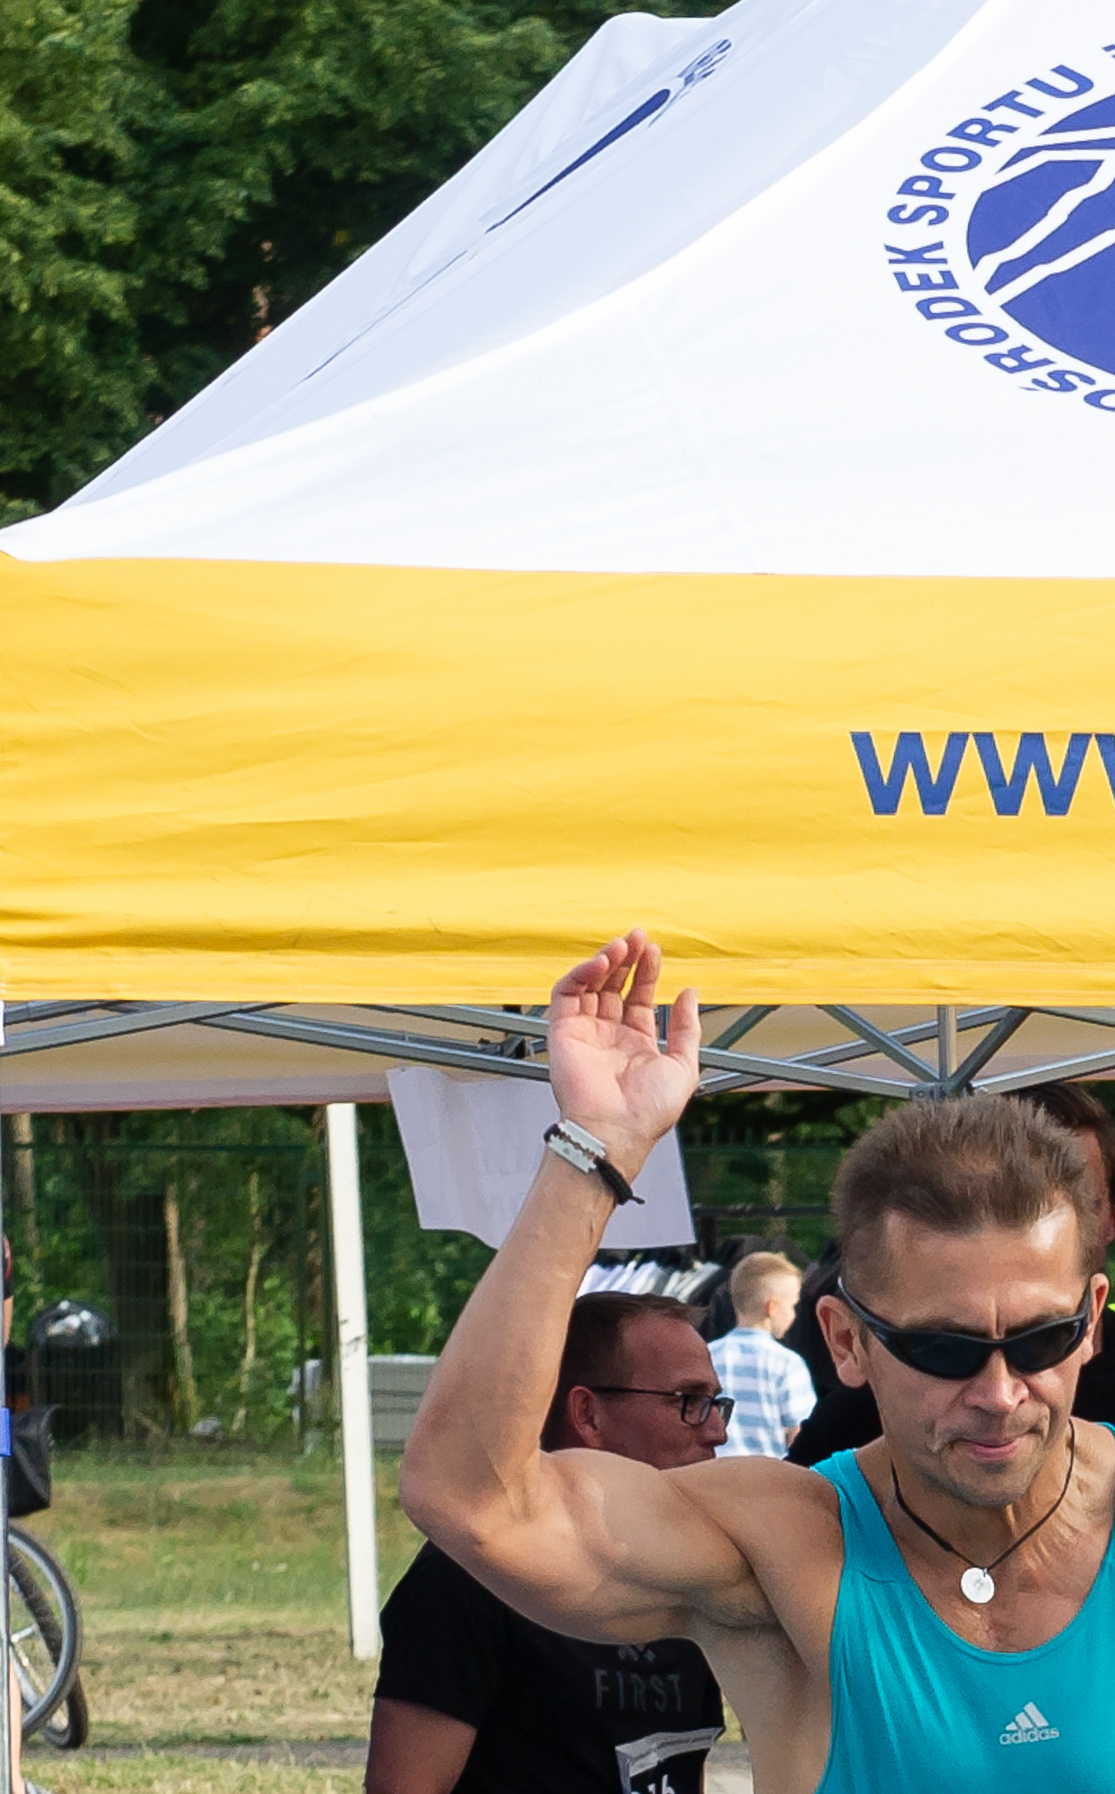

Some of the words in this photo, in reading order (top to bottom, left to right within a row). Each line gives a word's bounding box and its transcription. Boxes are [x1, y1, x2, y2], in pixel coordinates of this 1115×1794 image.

[886, 65, 1095, 226] SPORTU
[593, 1668, 682, 1713] FIRST
[999, 1727, 1060, 1746] adidas
